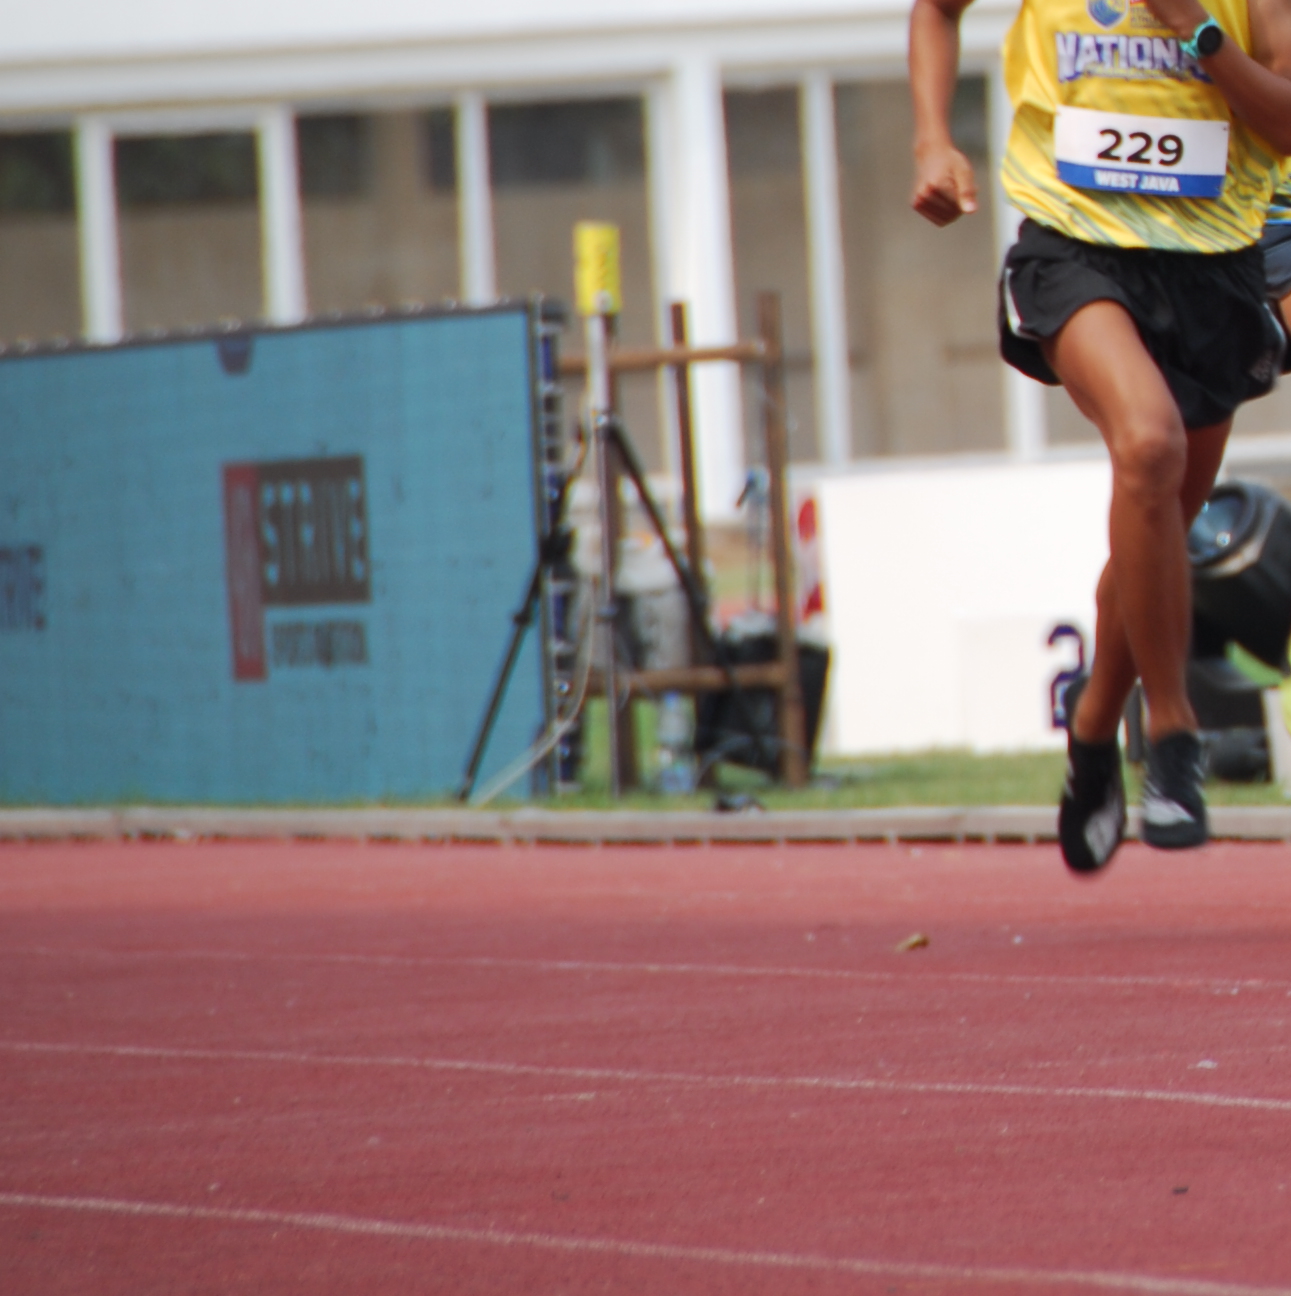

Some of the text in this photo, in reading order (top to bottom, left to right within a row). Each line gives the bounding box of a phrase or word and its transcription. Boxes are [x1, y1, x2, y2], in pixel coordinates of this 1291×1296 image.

[1097, 128, 1184, 167] 229
[1094, 168, 1180, 192] WEST JAVA
